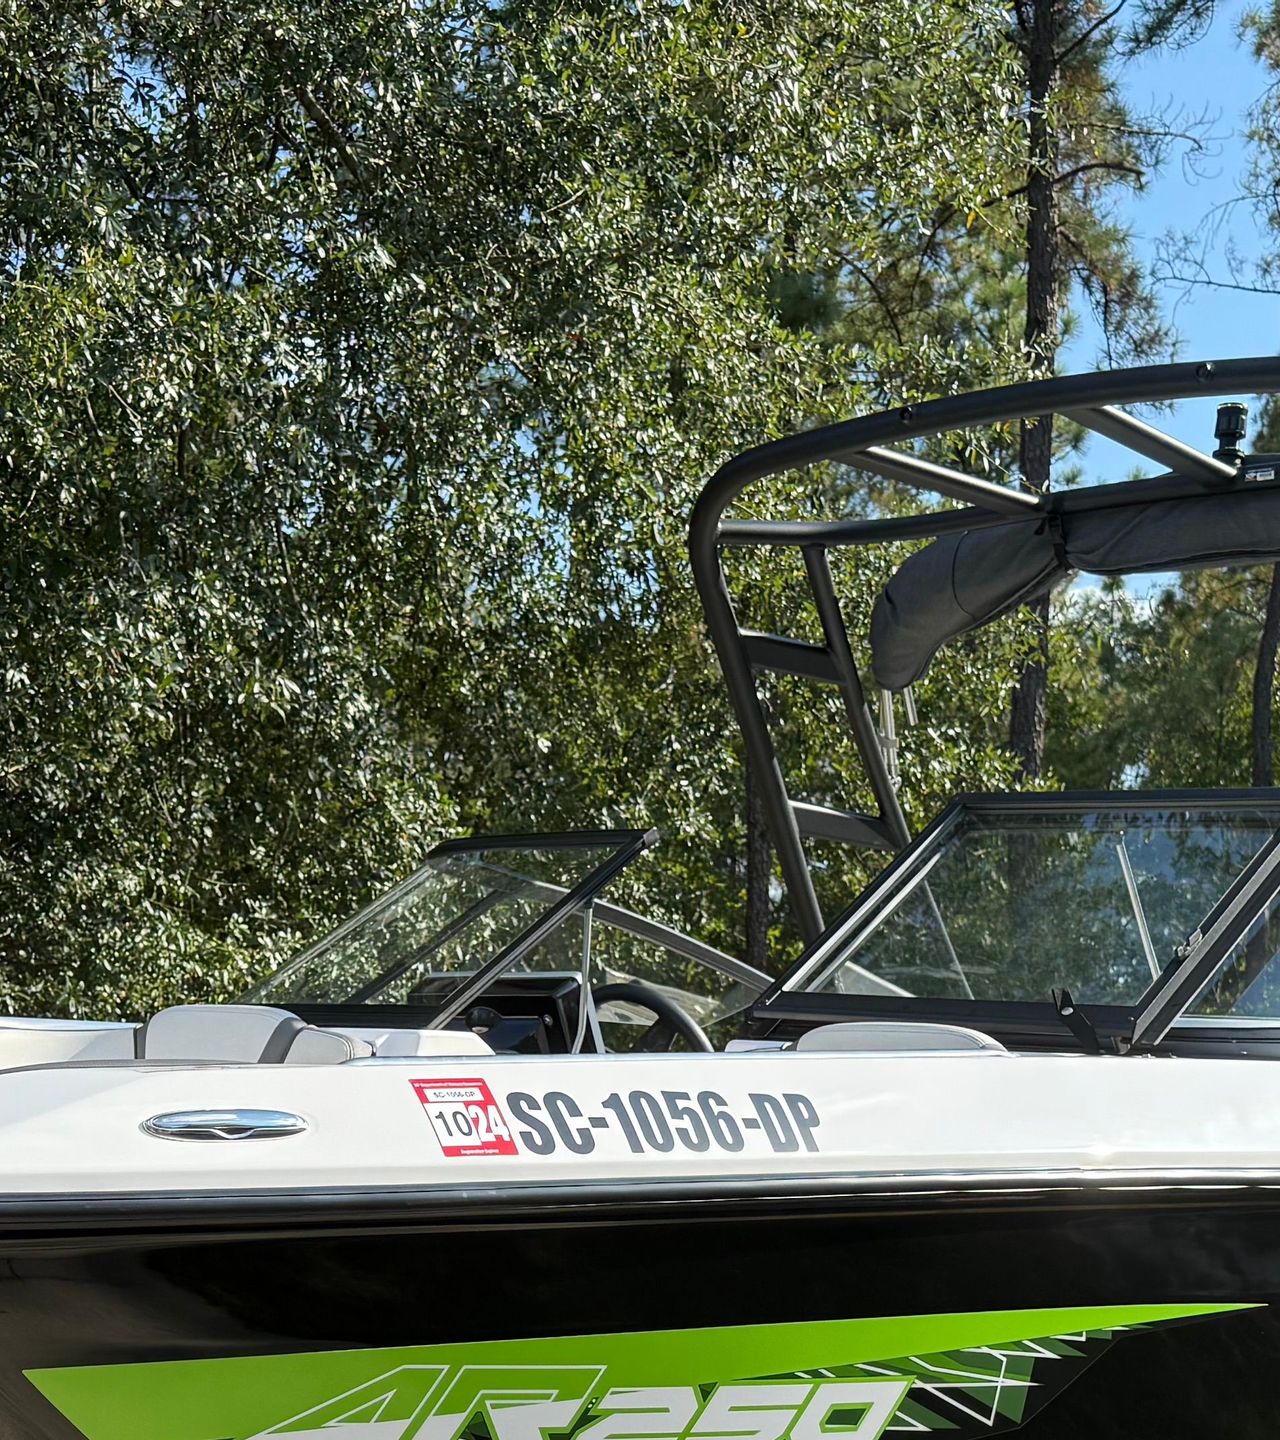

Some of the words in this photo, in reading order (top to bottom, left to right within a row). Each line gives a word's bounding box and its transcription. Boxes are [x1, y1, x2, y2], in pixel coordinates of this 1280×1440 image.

[434, 1110, 473, 1137] 10
[467, 1104, 512, 1142] 24
[506, 1091, 821, 1156] SC-1056-DP
